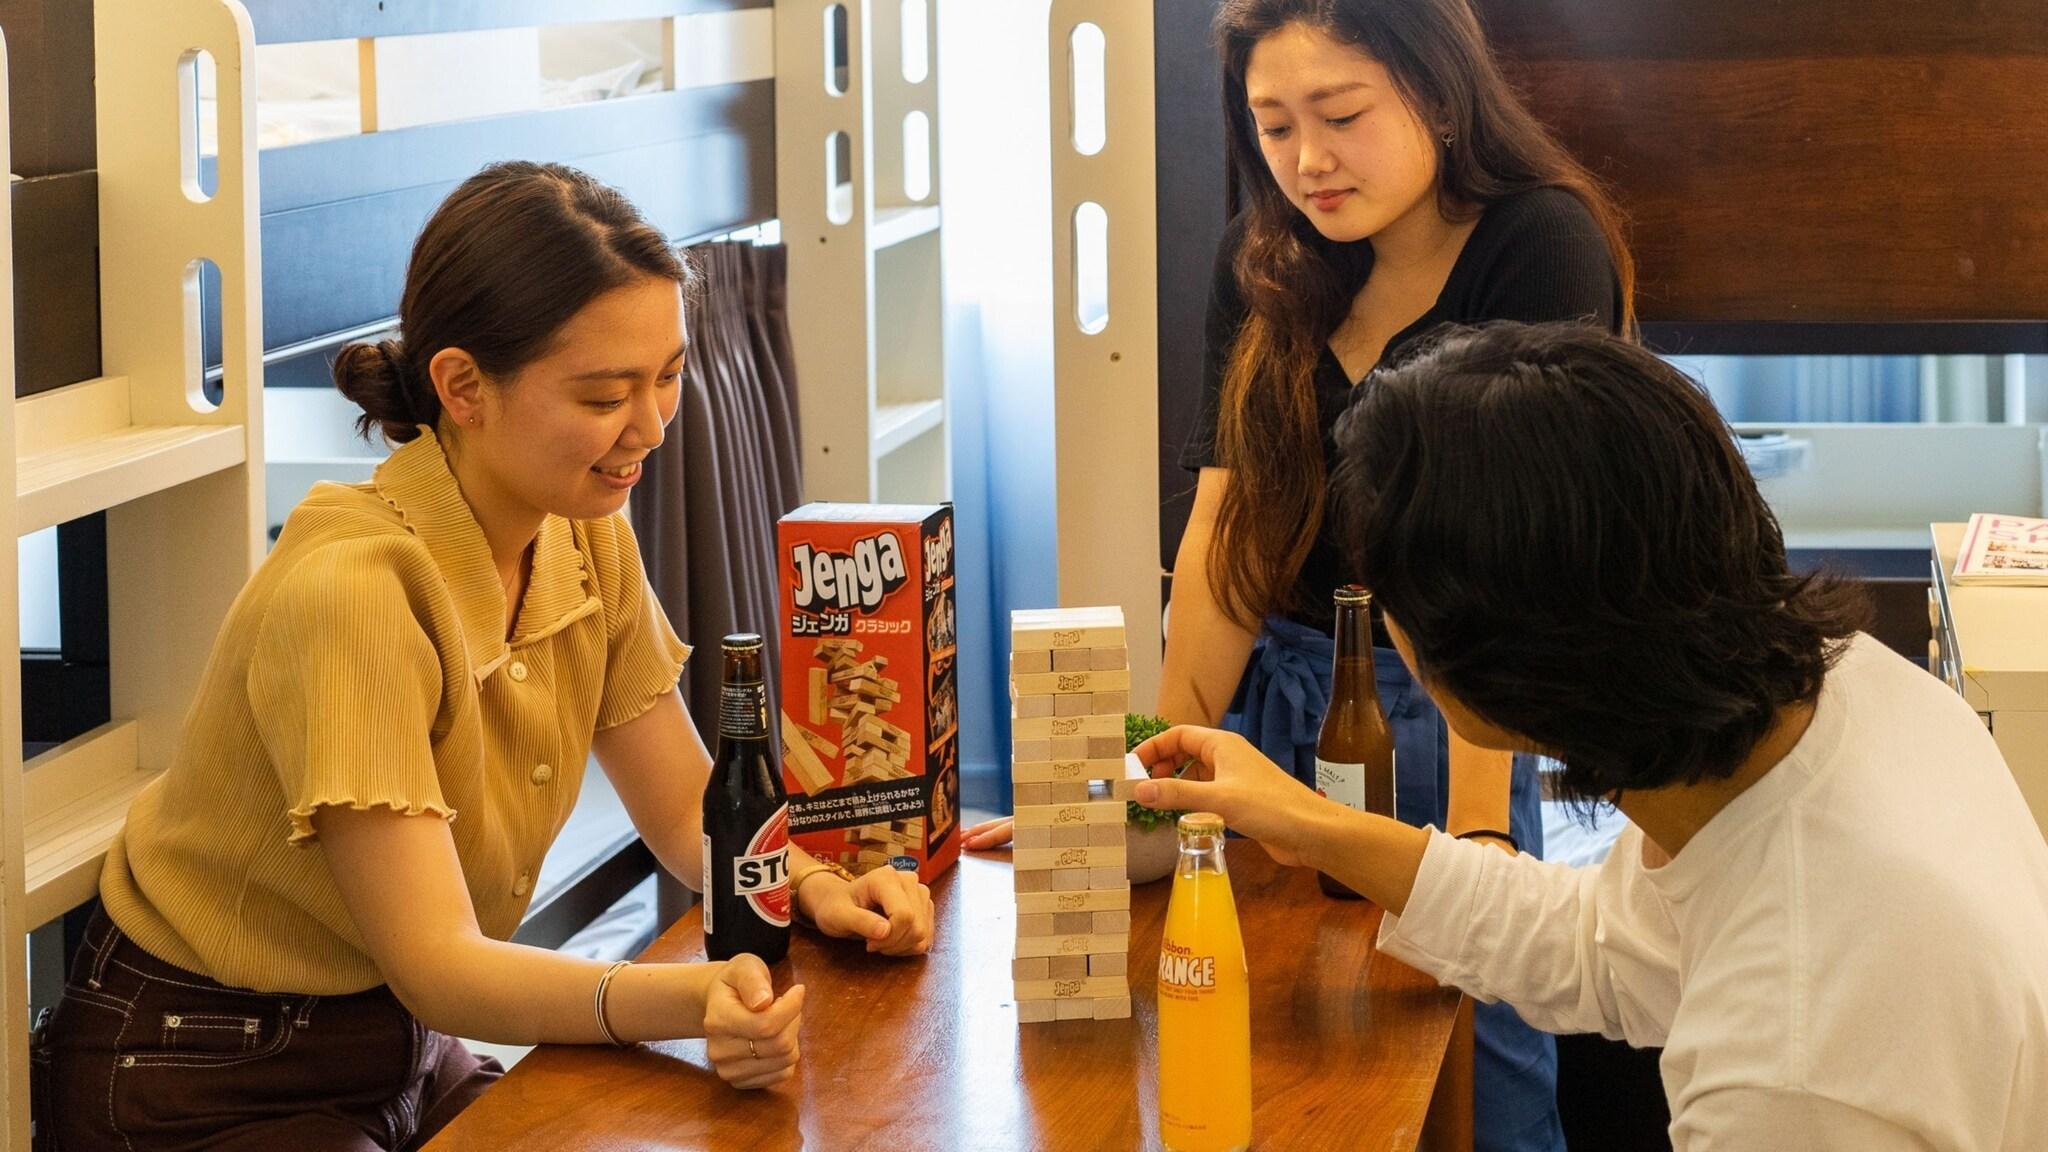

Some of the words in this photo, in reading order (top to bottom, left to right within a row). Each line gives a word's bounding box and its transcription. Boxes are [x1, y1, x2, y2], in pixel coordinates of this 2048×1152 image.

[793, 531, 906, 609] Jenga
[792, 613, 849, 634] ジェンガ
[855, 619, 912, 634] クラシック
